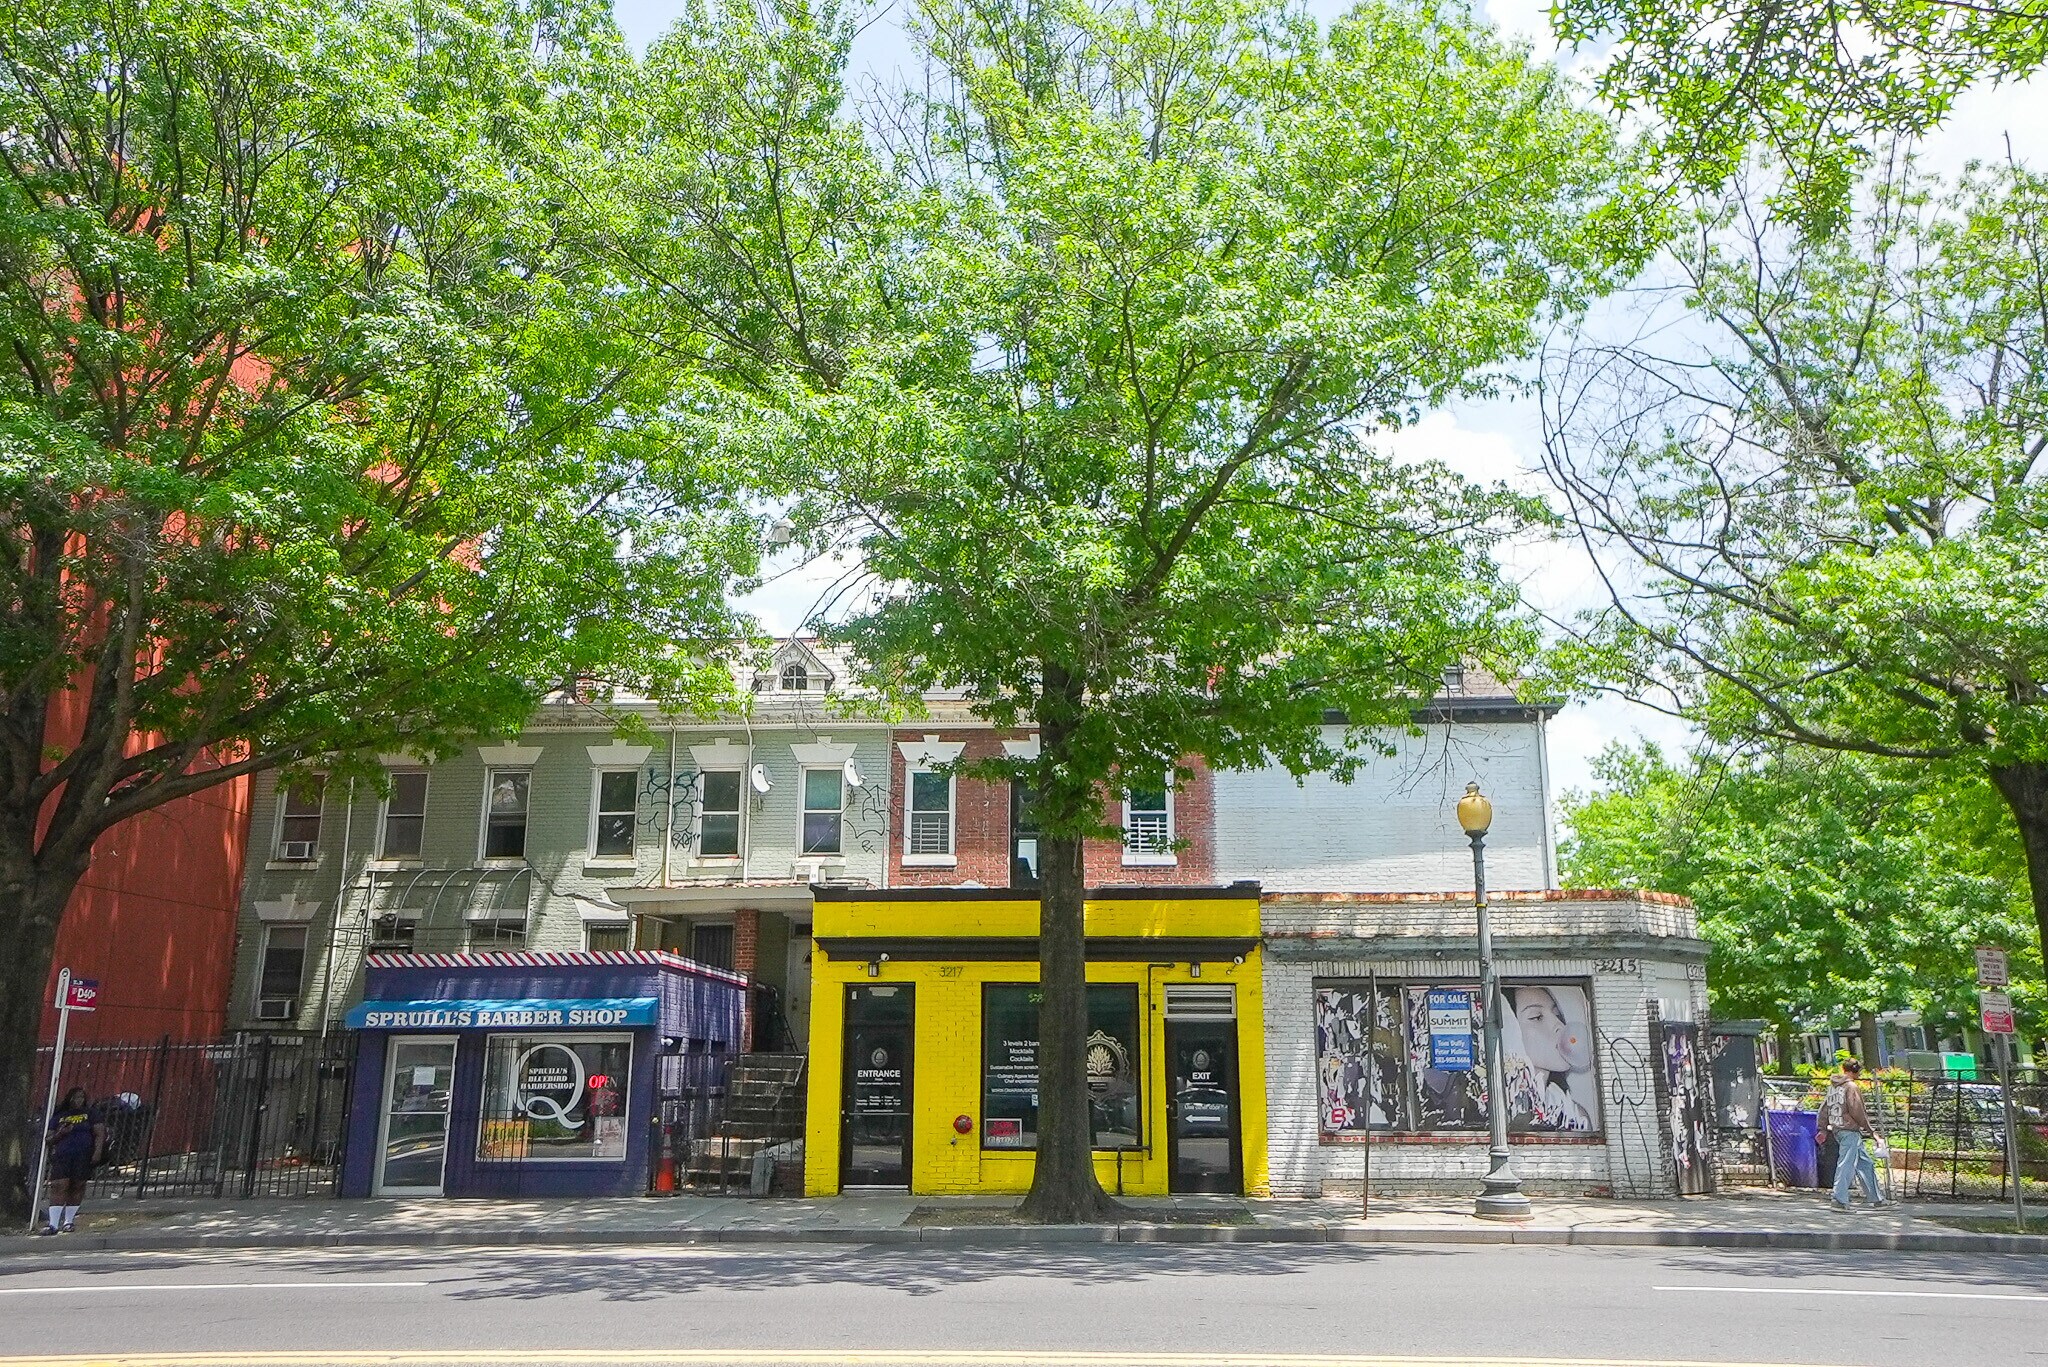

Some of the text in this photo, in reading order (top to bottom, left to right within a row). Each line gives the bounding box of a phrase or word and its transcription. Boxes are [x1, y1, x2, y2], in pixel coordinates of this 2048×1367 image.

[940, 965, 964, 978] 3217
[1429, 994, 1468, 1005] FOR SALE
[365, 1009, 628, 1027] SPRUILL'S BARBER SHOP
[1430, 1017, 1468, 1026] SUMMIT
[1009, 1055, 1034, 1063] Cocktails
[528, 1067, 568, 1075] SPRUILL'S
[857, 1069, 901, 1078] ENTRANCE
[1192, 1071, 1211, 1080] EXIT
[528, 1075, 568, 1083] BLUEBIRD
[589, 1074, 618, 1089] OPEN
[511, 1043, 586, 1129] Q
[520, 1082, 575, 1090] BARBERSHOP
